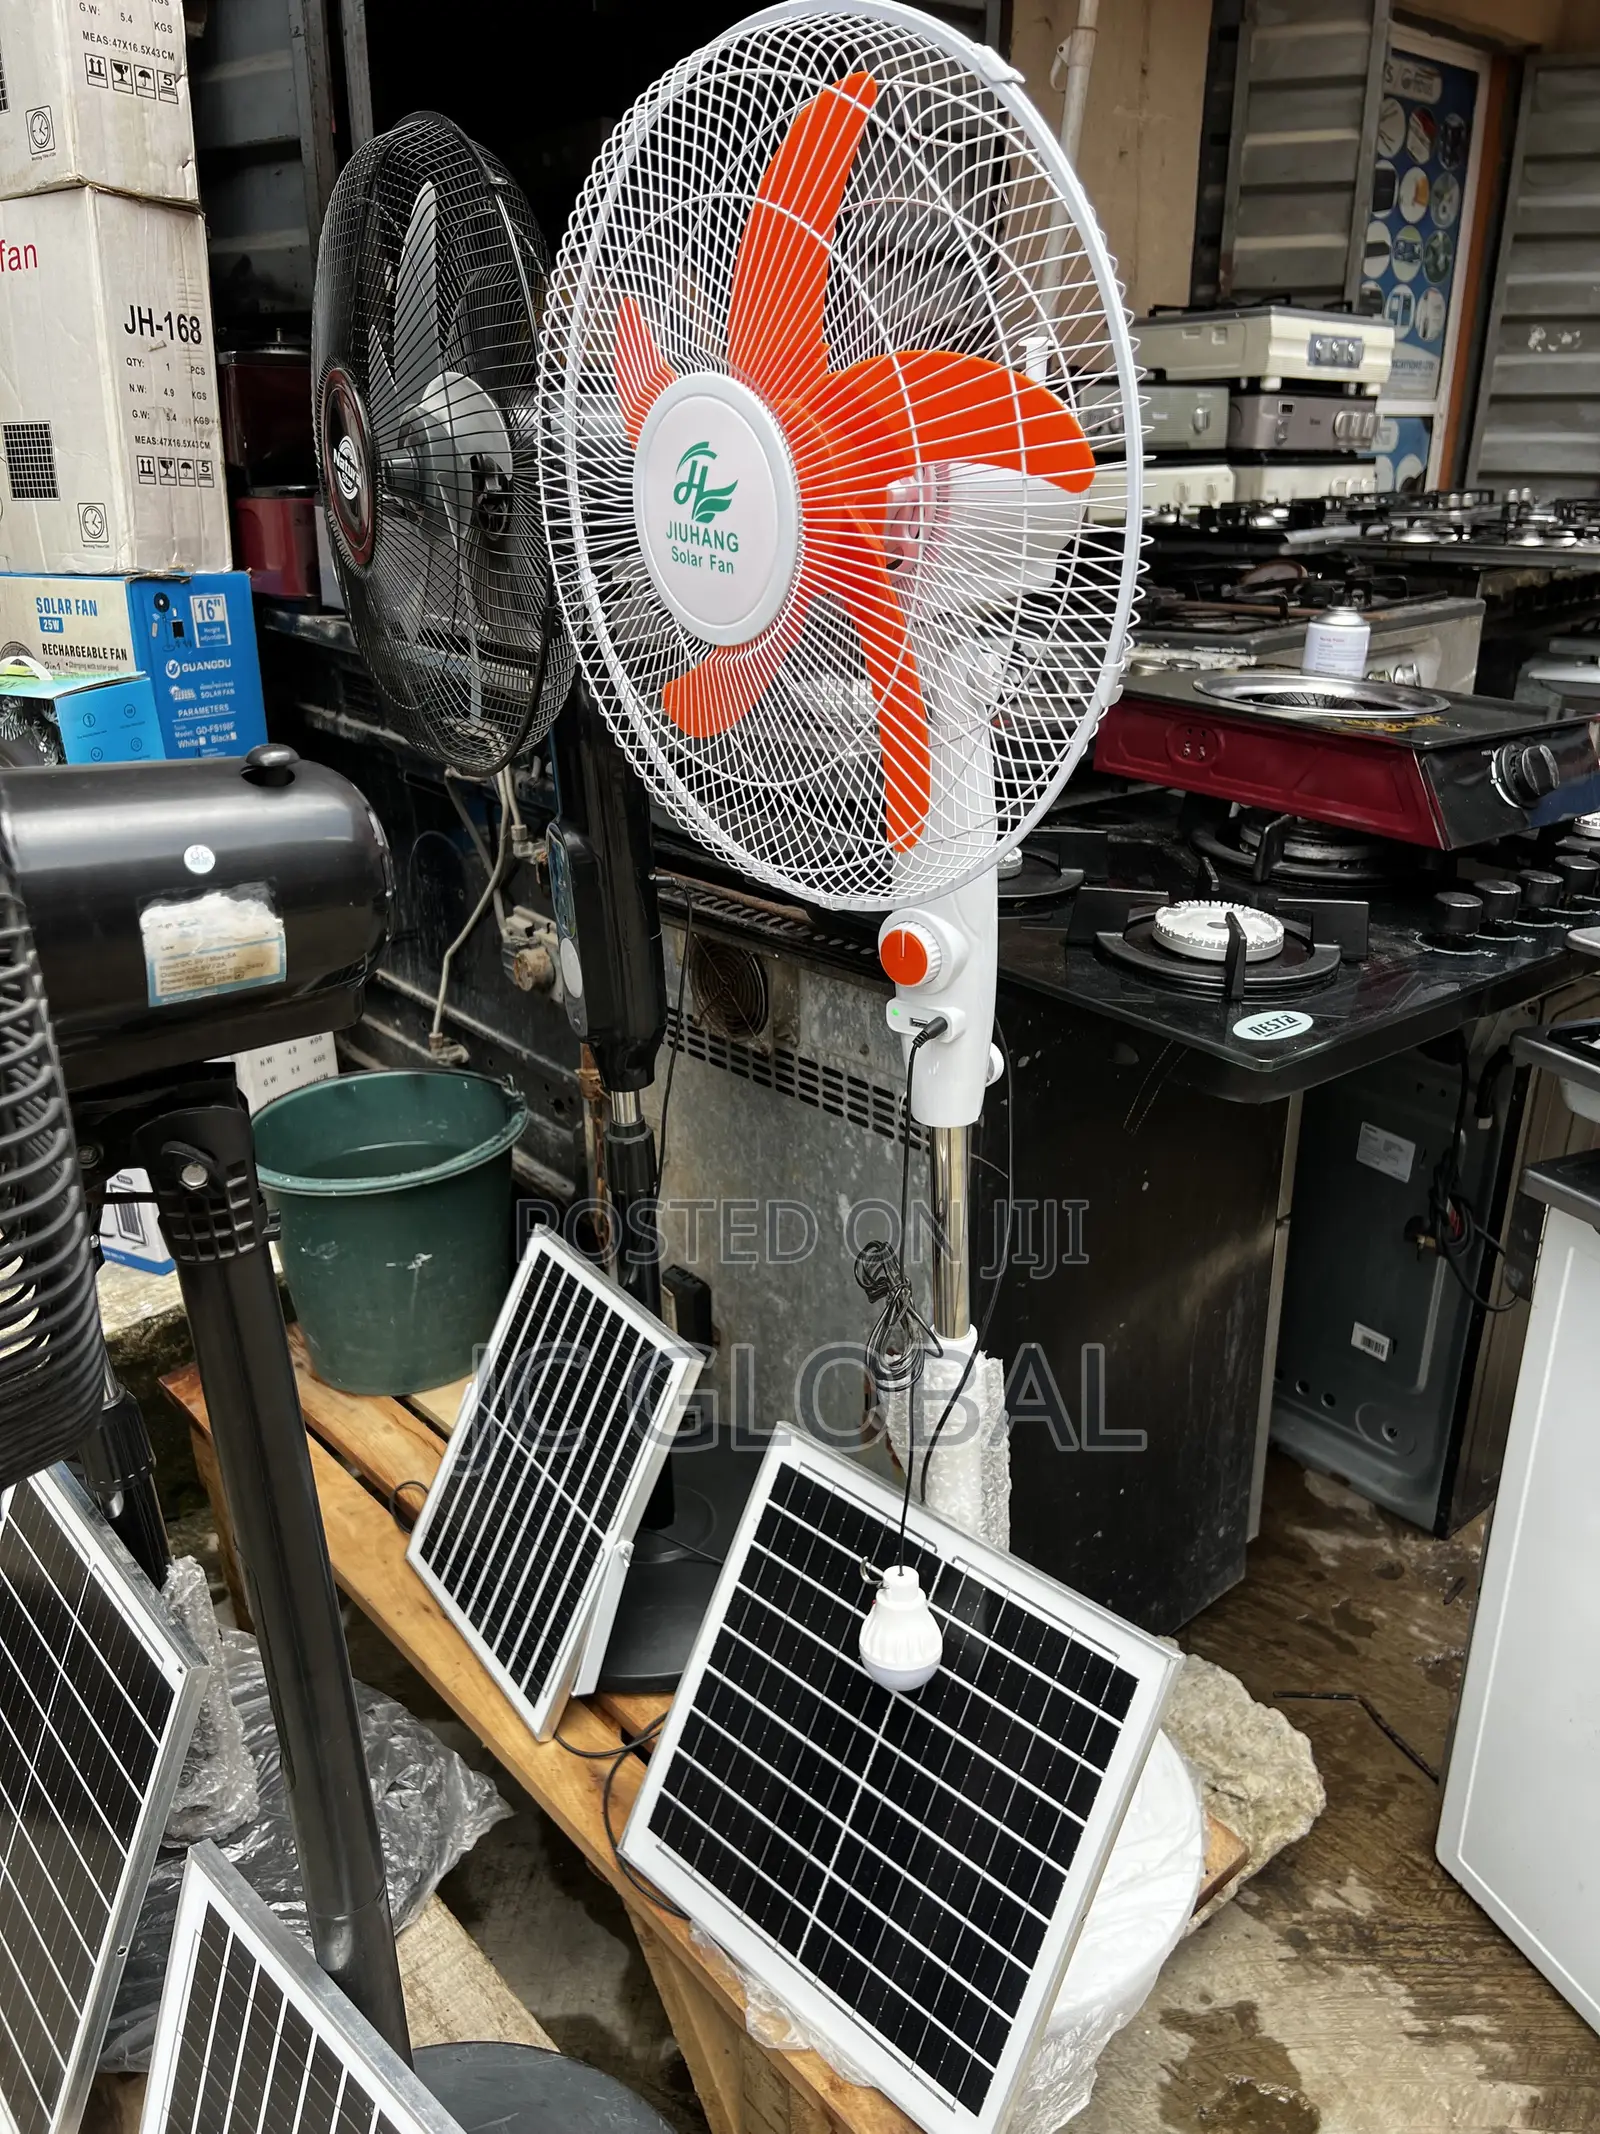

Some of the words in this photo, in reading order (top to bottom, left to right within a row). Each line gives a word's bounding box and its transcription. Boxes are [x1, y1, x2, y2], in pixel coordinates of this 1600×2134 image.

[79, 2, 100, 15] G.W:
[120, 12, 133, 23] 5.4
[154, 21, 173, 33] KGS
[0, 239, 38, 272] fan
[124, 304, 202, 345] JH-168
[126, 357, 145, 367] QTY:
[166, 362, 170, 371] 1
[190, 366, 206, 376] PCS
[129, 383, 147, 393] N.W:
[163, 388, 175, 397] 4.9
[191, 390, 207, 401] KGS
[131, 409, 150, 419] G.W:
[166, 413, 177, 421] 5.4
[193, 416, 210, 426] KGS
[666, 521, 739, 553] JIUHANG
[671, 546, 703, 568] Solar
[709, 554, 734, 574] Fan
[36, 597, 72, 615] SOLAR
[75, 599, 98, 617] FAN
[43, 619, 60, 631] 25W
[42, 643, 108, 660] RECHARGEABLE
[109, 647, 128, 661] FAN
[178, 703, 229, 717] PARAMETERS
[178, 739, 200, 749] White
[211, 733, 231, 744] Black
